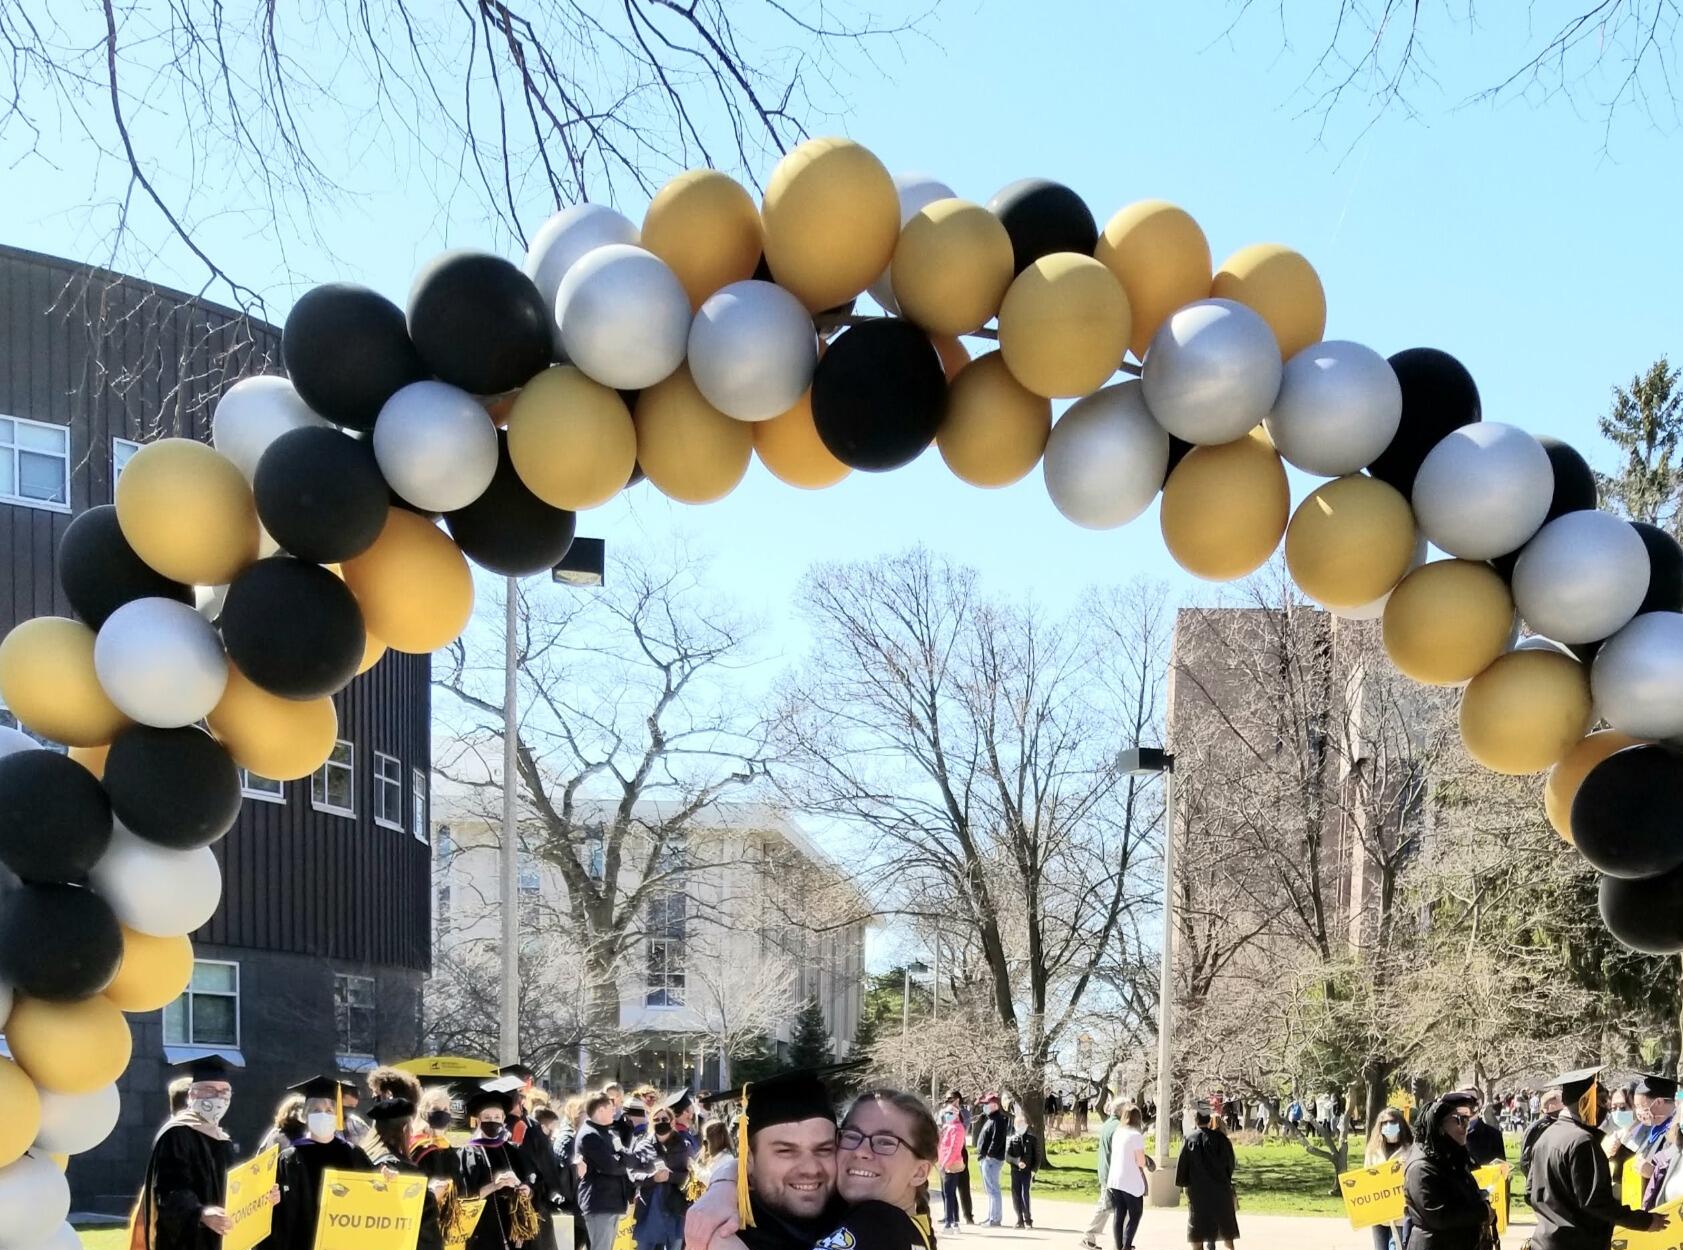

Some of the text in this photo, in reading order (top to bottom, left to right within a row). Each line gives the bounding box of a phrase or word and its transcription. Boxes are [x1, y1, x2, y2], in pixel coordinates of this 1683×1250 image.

[1351, 1195, 1371, 1207] YOU
[1373, 1189, 1391, 1201] DID
[328, 1213, 412, 1230] YOU DID IT!
